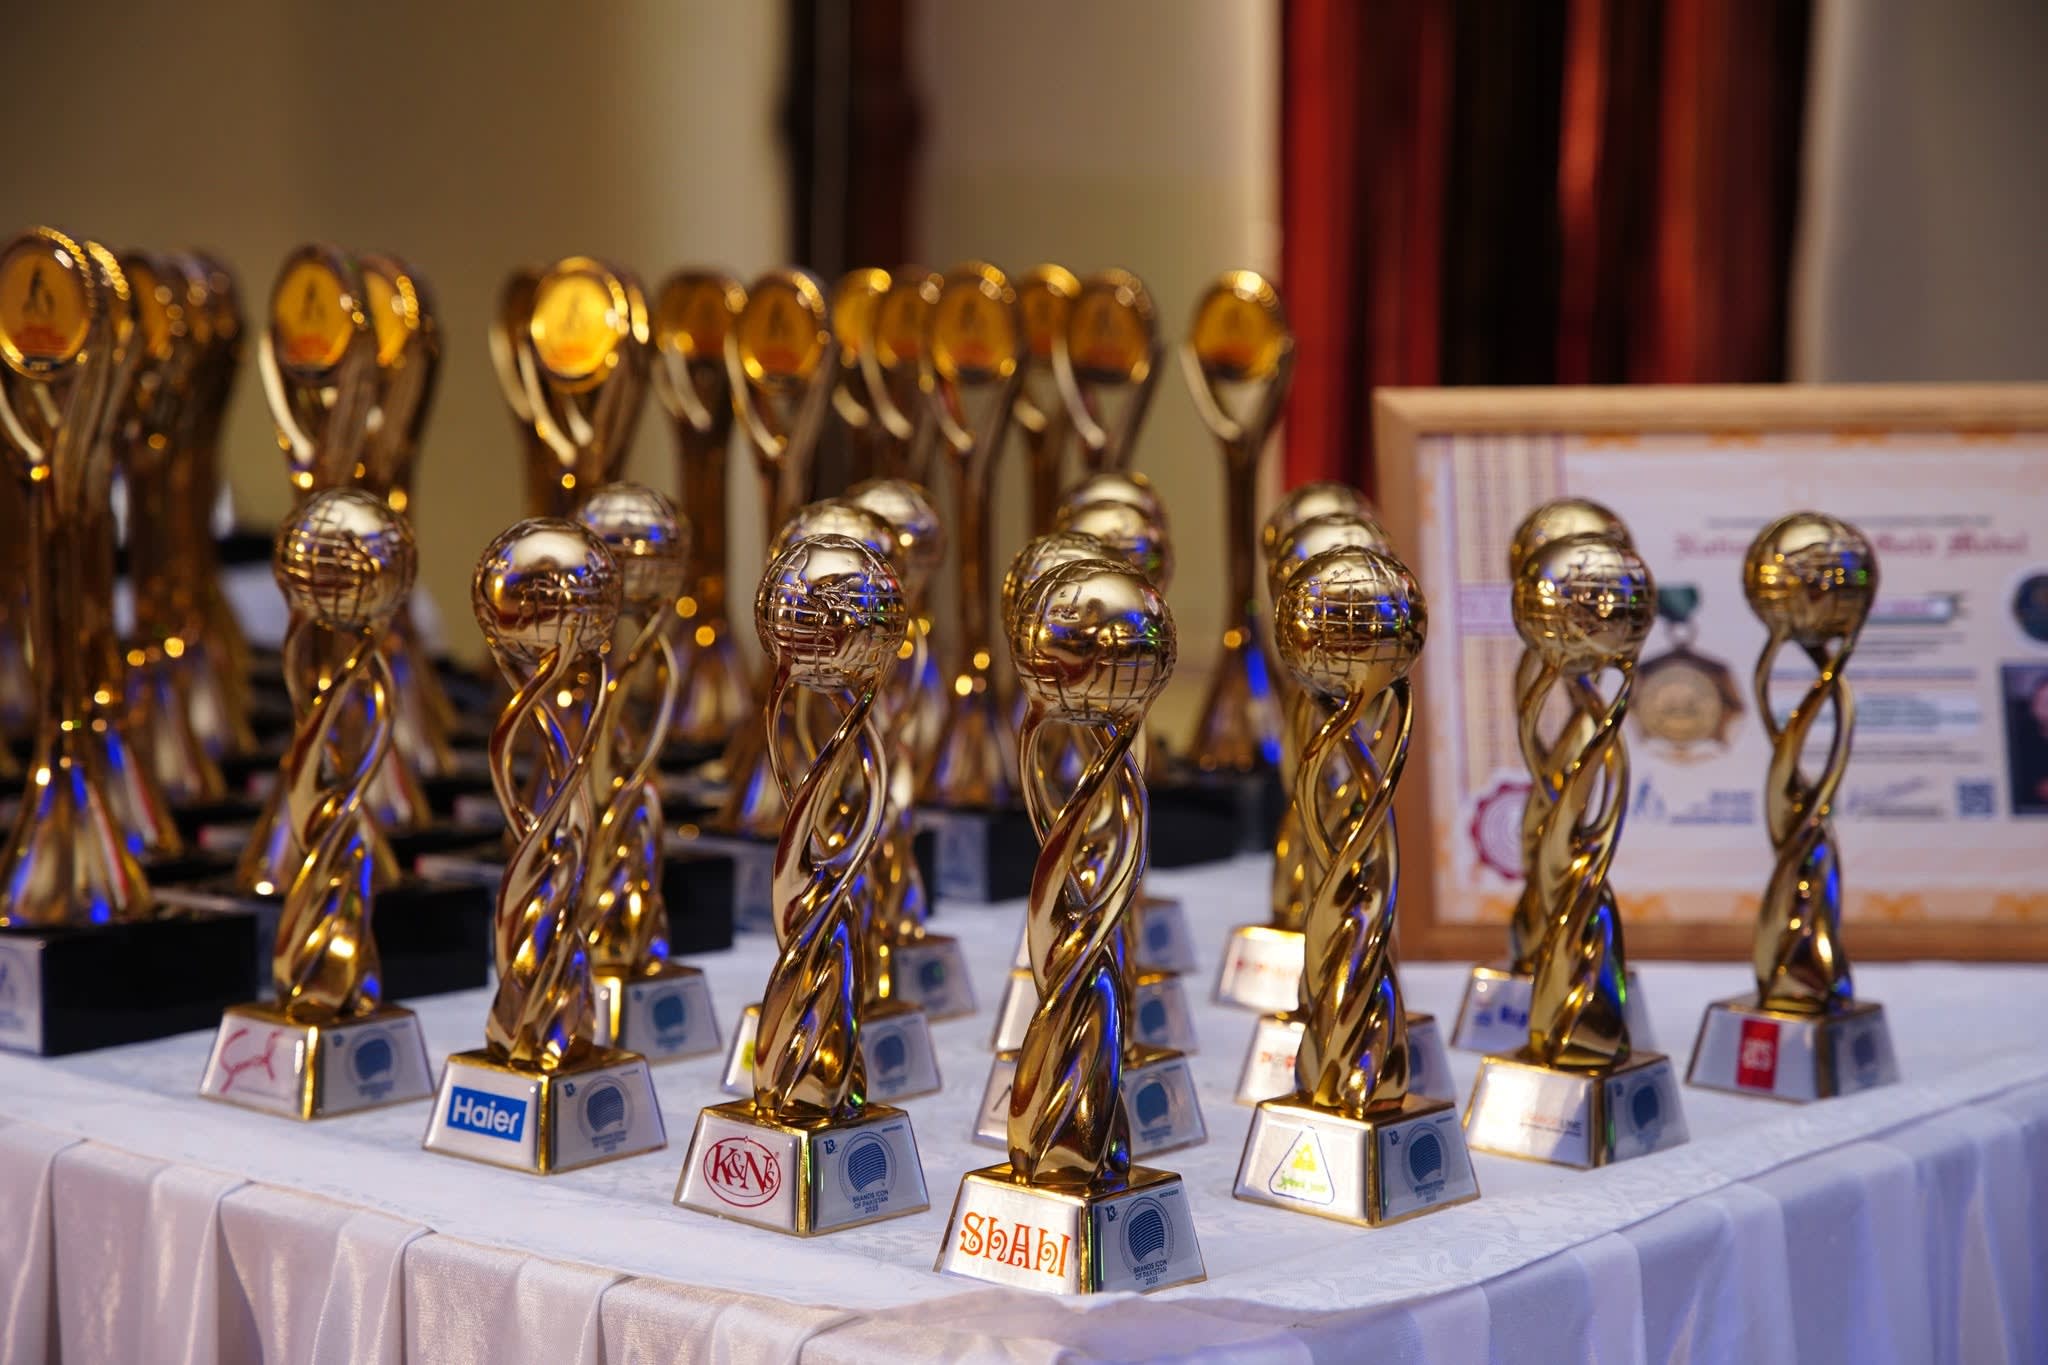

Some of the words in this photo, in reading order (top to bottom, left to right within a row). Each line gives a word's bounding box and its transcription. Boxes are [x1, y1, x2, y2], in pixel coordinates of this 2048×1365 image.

[452, 1095, 520, 1135] Haier
[824, 1139, 836, 1155] 13
[711, 1145, 776, 1194] K&N's
